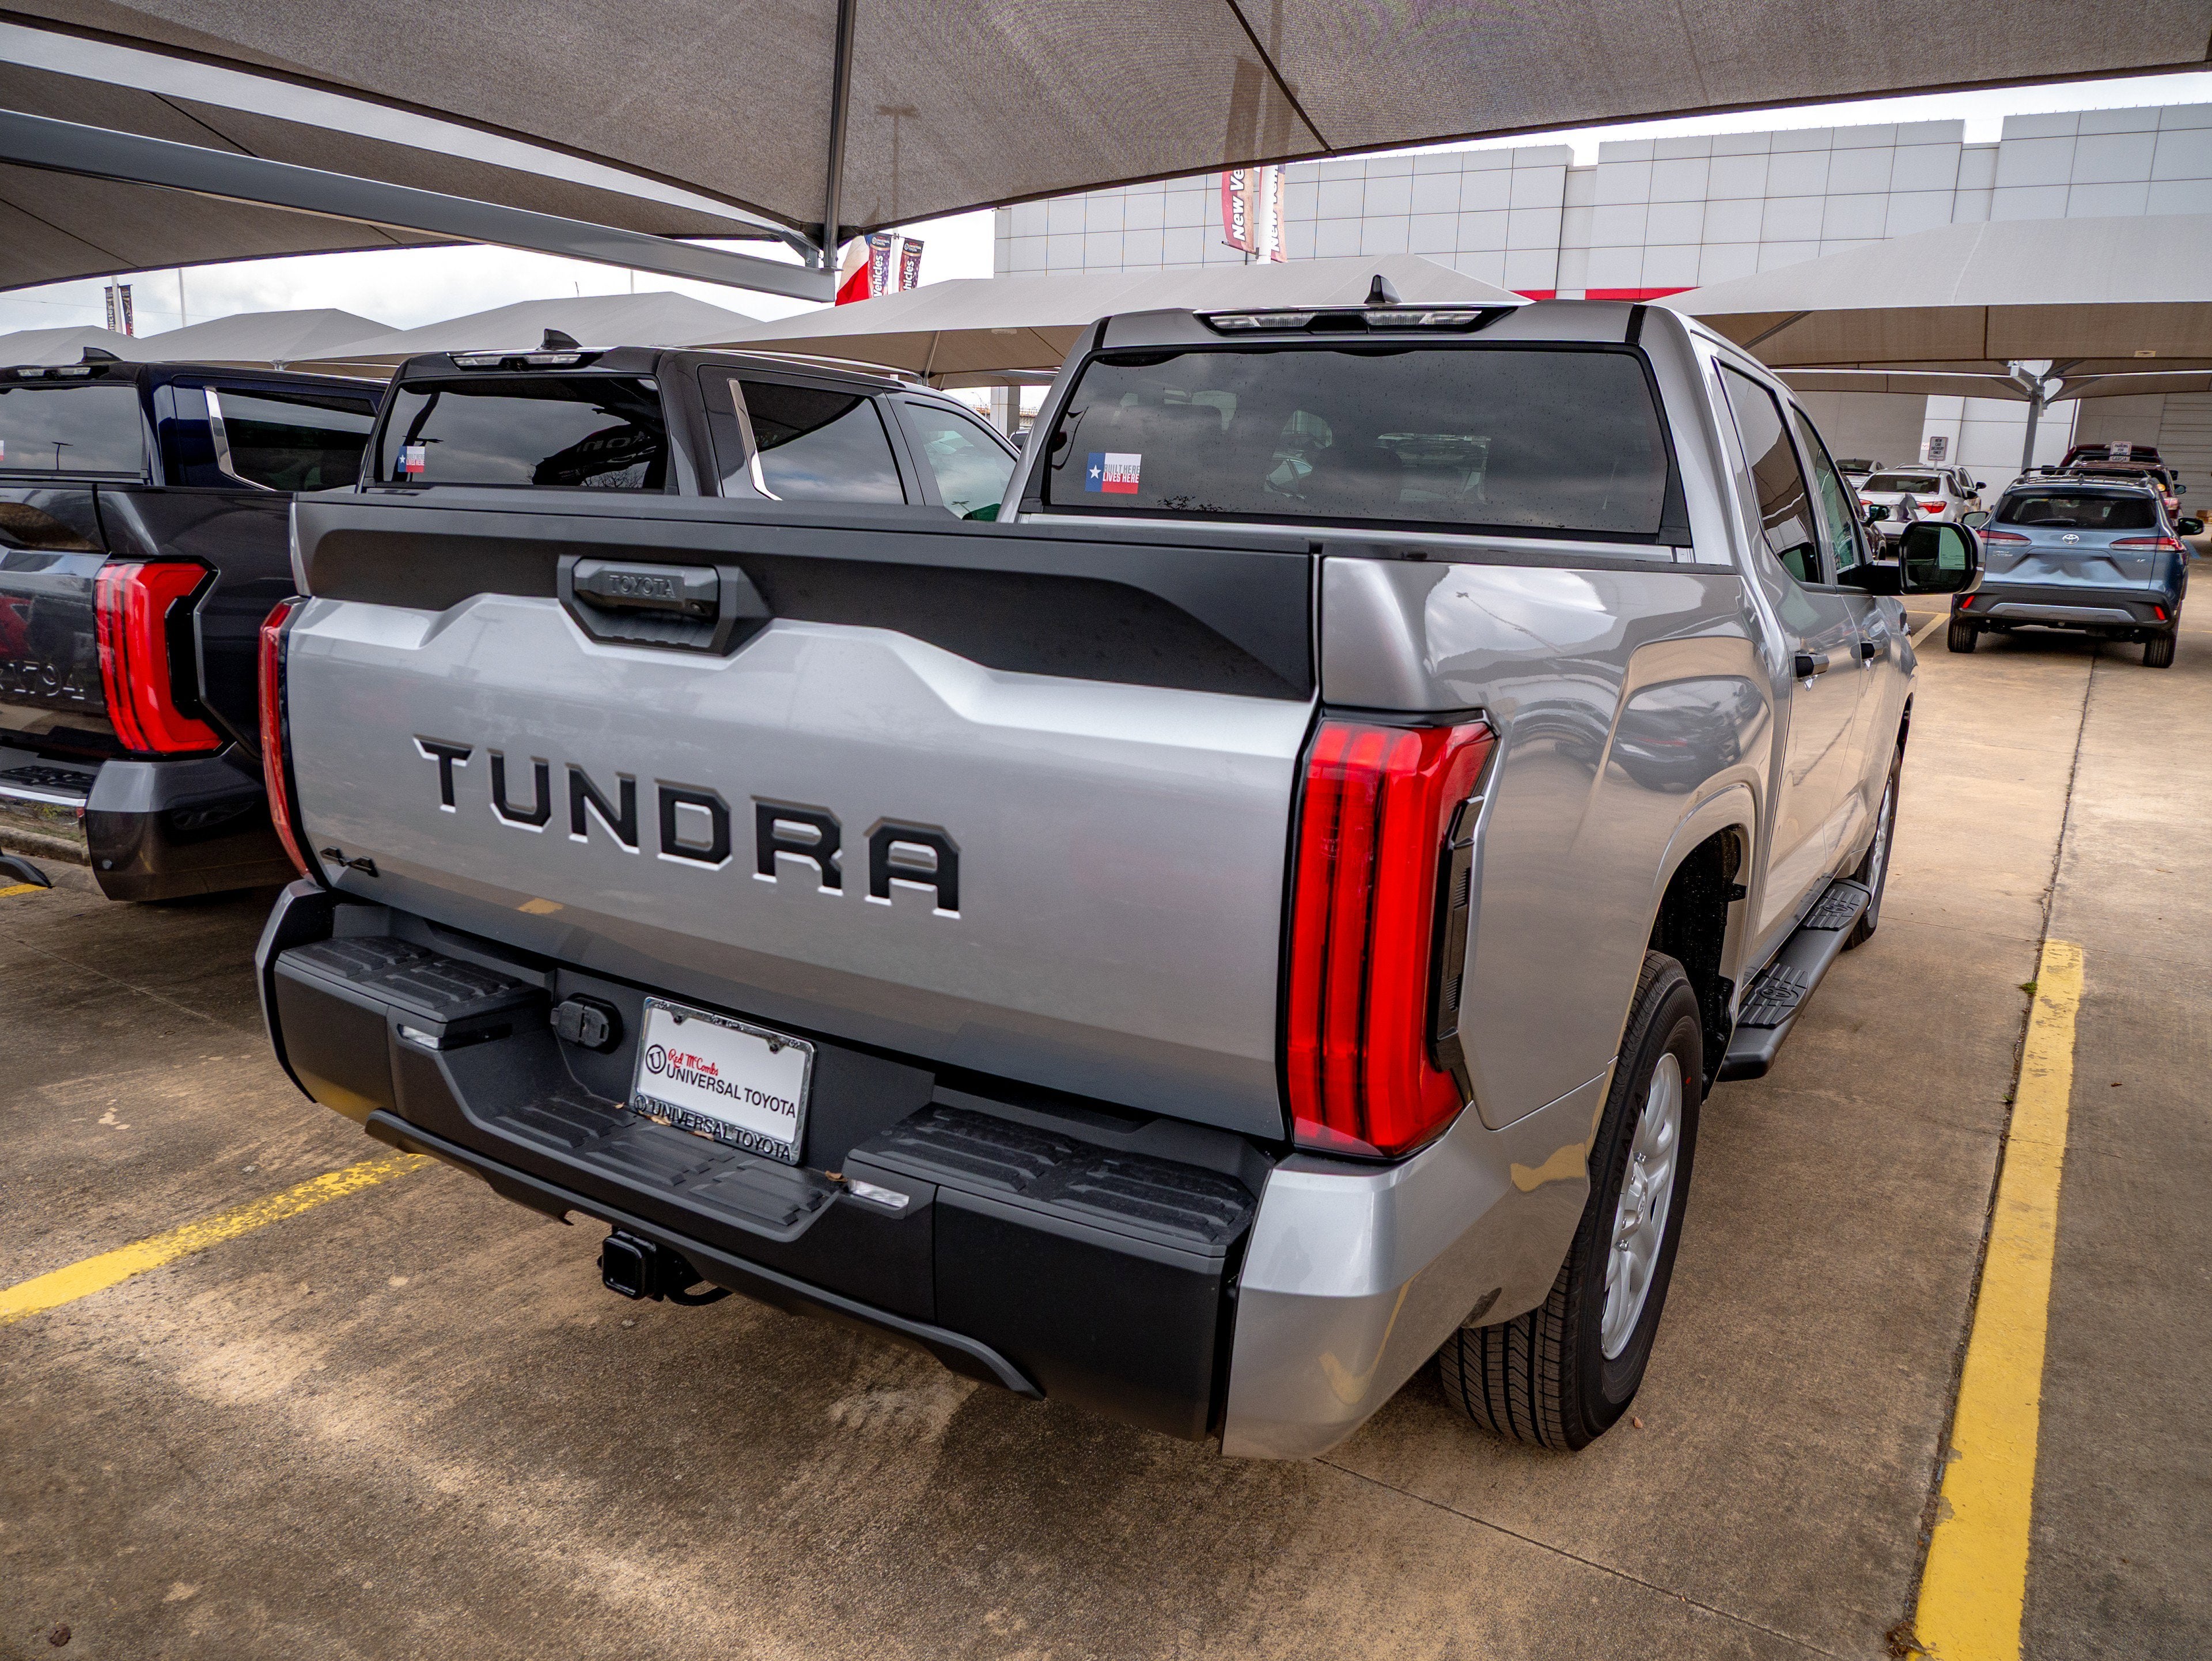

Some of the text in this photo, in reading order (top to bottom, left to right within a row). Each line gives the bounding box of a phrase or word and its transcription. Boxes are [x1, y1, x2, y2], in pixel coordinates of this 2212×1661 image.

[1232, 195, 1245, 241] New
[873, 255, 884, 297] Vehicles
[1103, 472, 1139, 483] LIVES HERE
[1104, 464, 1141, 474] BUILT HERE
[609, 574, 676, 599] TOYOTA
[412, 733, 961, 919] TUNDRA
[668, 1048, 684, 1069] Red
[666, 1064, 796, 1118] UNIVERSAL TOYOTA
[652, 1099, 793, 1161] UNIVERSAL TOYOTA
